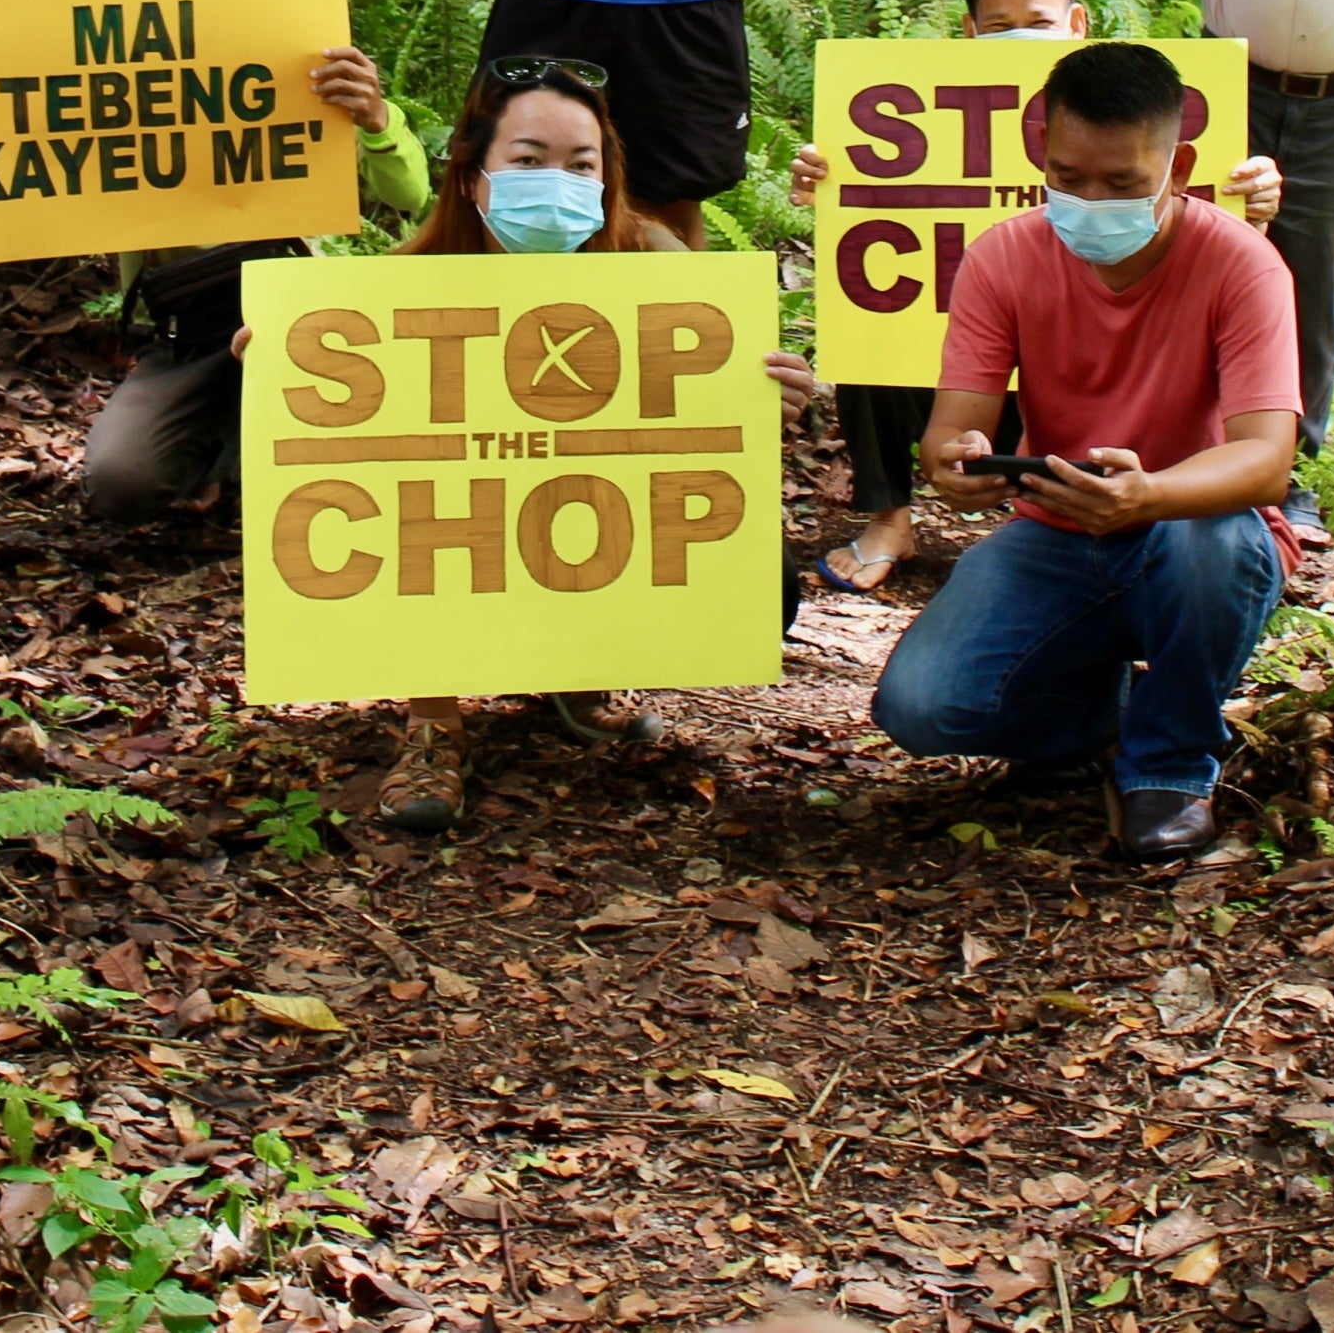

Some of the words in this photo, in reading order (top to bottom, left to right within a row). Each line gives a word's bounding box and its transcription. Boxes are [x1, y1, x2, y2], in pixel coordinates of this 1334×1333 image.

[73, 0, 195, 66] MAI
[212, 119, 323, 186] ME'
[282, 302, 734, 427] STOP
[472, 431, 549, 460] THE
[272, 470, 745, 600] CHOP
